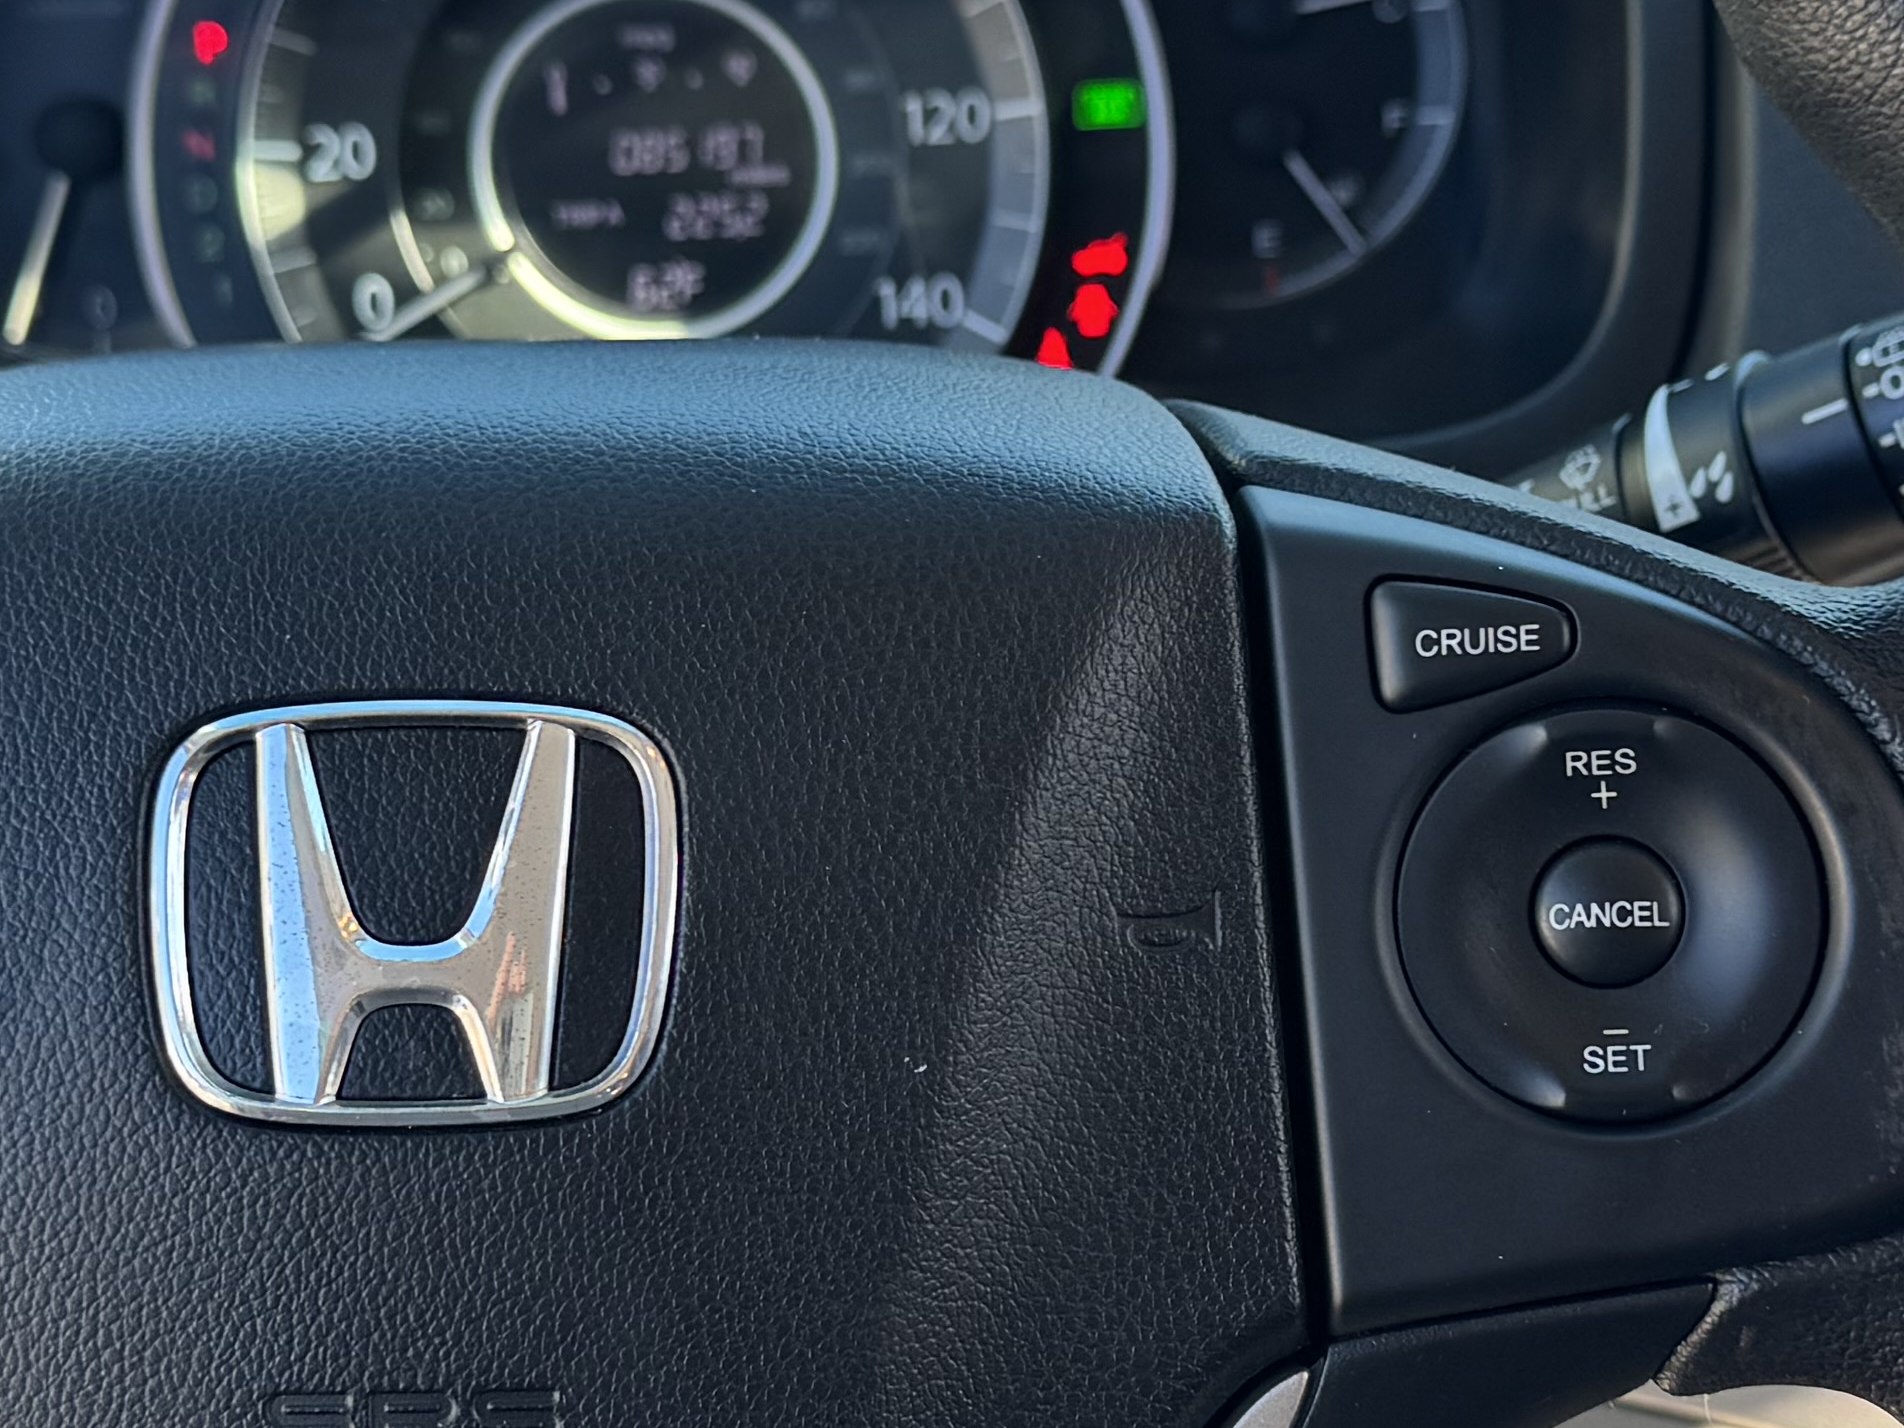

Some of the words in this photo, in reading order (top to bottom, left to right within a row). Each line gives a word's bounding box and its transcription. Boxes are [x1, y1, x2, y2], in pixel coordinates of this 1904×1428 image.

[903, 88, 991, 146] 120
[304, 122, 376, 182] 20
[352, 272, 394, 332] 0
[875, 272, 963, 330] 140
[1414, 623, 1542, 659] CRUISE
[1565, 747, 1638, 777] RES
[1548, 900, 1671, 931] CANCEL
[1582, 1044, 1653, 1075] SET
